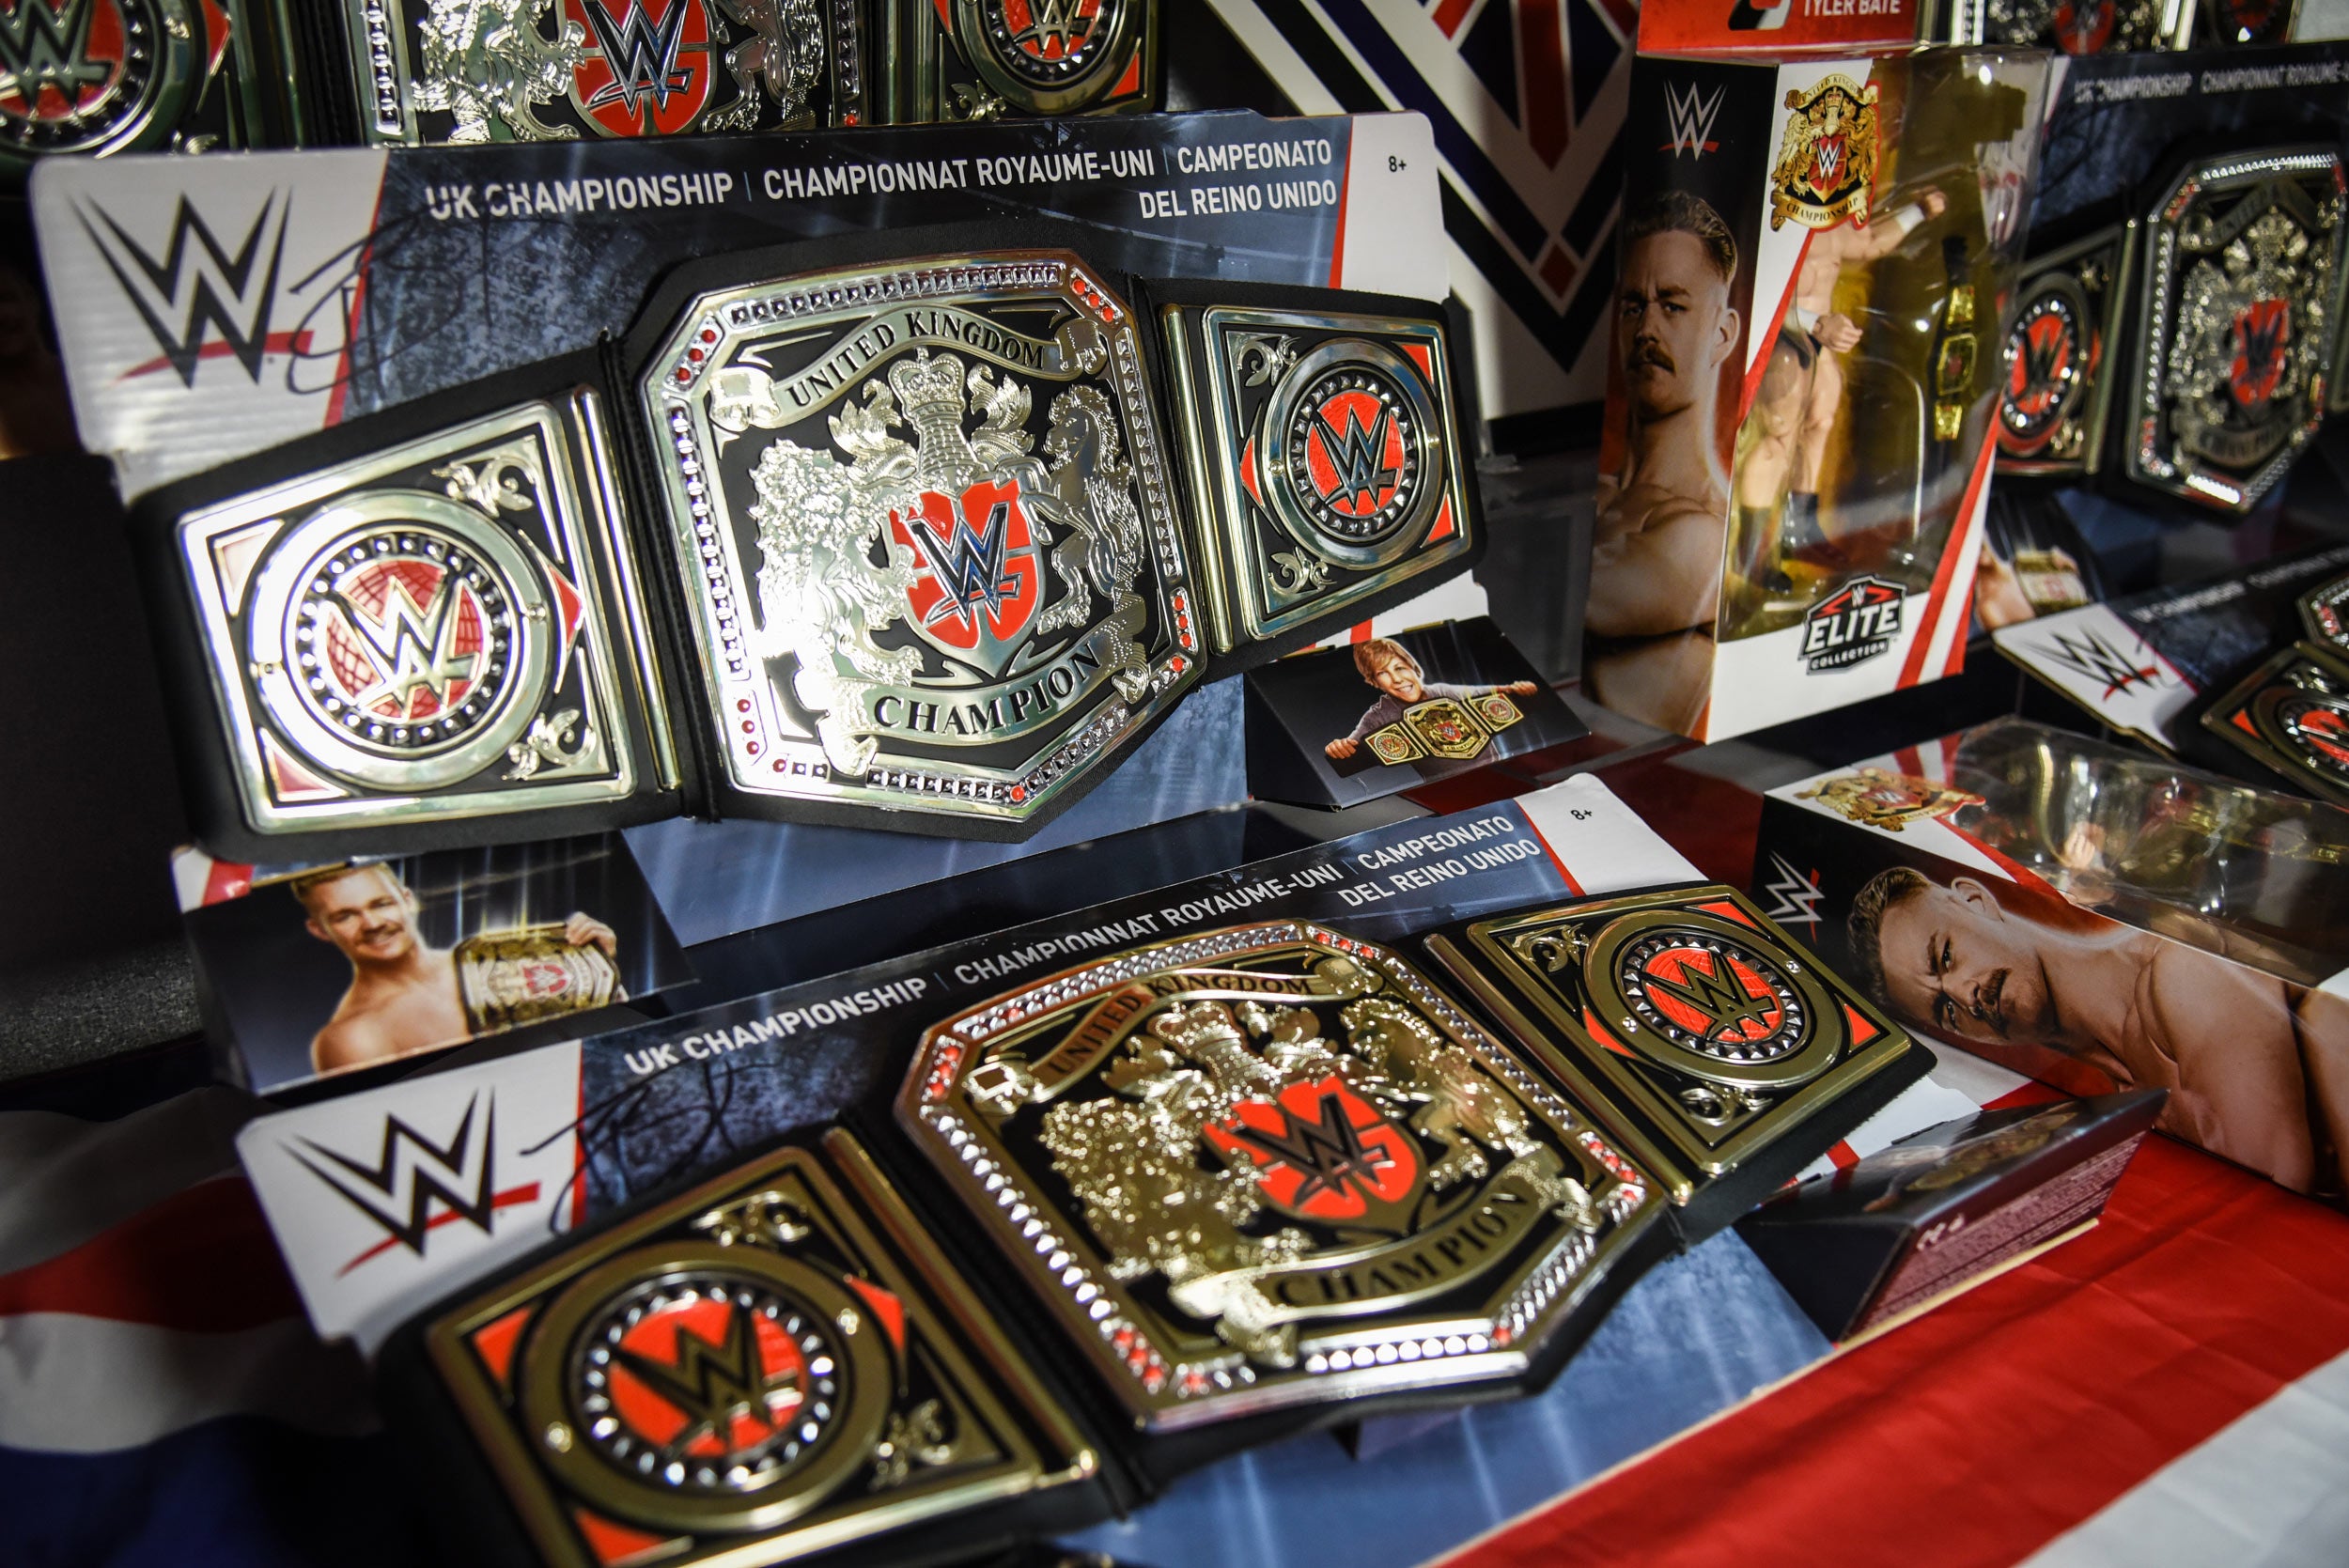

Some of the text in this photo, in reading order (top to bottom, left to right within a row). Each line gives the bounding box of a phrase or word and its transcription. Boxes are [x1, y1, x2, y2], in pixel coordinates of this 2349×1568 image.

[425, 139, 1332, 221] UK CHAMPIONSHIP CHAMPIONNAT ROYAUME-UNI CAMPEONATO
[1139, 179, 1336, 219] DEL REINO UNIDO
[1388, 155, 1408, 173] 8+
[1786, 195, 1859, 222] CHAMPIONSHIP
[784, 310, 1045, 408] UNITED KINGDOM
[1804, 598, 1901, 652] ELITE
[1811, 640, 1887, 670] COLLECTION
[874, 640, 1101, 736] CHAMPION
[1570, 807, 1593, 821] 8+
[1337, 837, 1542, 908] DEL REINO UNIDO
[624, 815, 1516, 1076] UK CHAMPIONSHIP CHAMPIONNAT ROYAUME-UNI CAMPEONATO
[1048, 973, 1314, 1076] UNITED KINGDOM
[1275, 1188, 1528, 1307] CHAMPION
